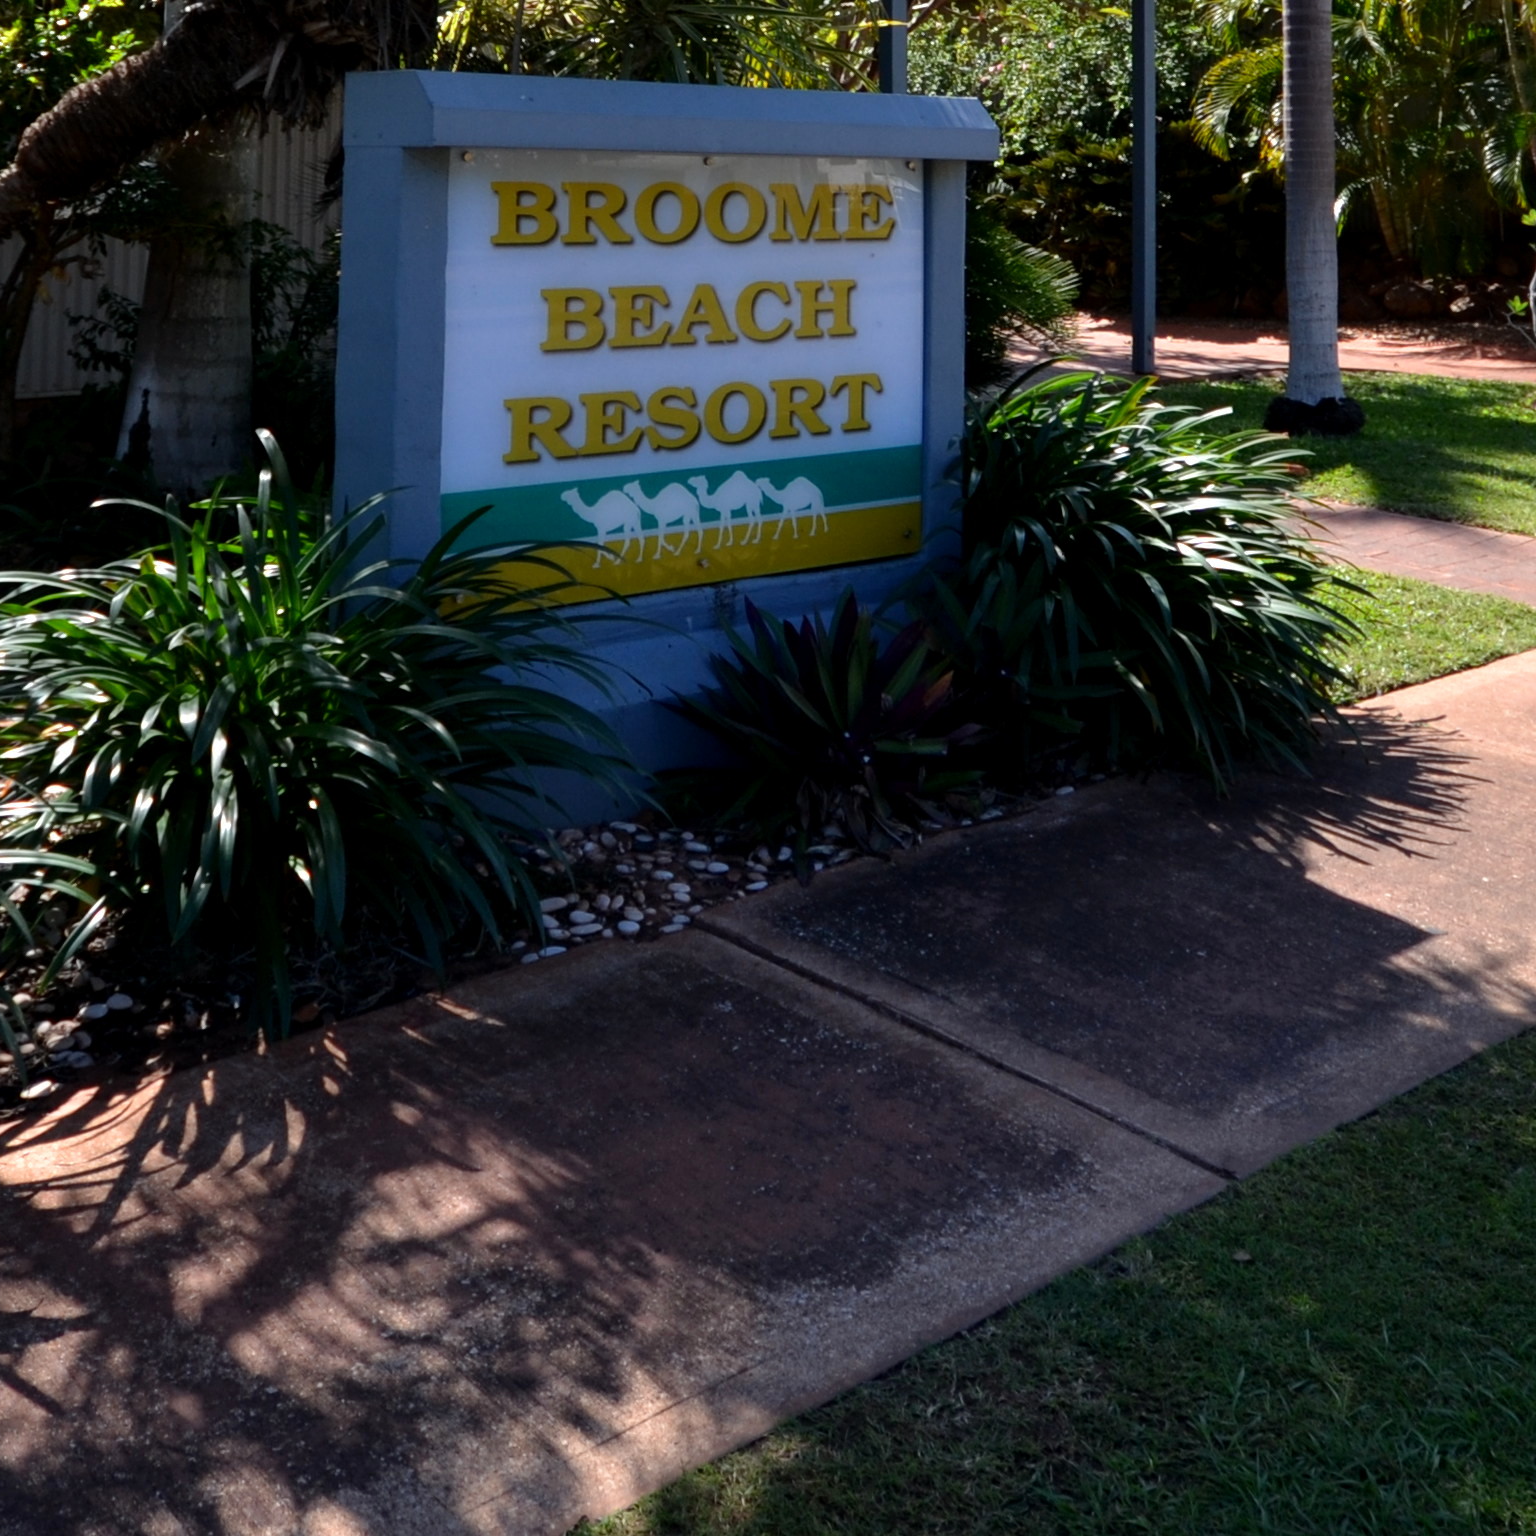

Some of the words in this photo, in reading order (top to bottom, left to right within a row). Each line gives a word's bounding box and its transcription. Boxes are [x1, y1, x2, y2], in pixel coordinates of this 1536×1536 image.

[489, 180, 897, 246] BROOME
[539, 278, 857, 352] BEACH
[502, 372, 884, 465] RESORT
